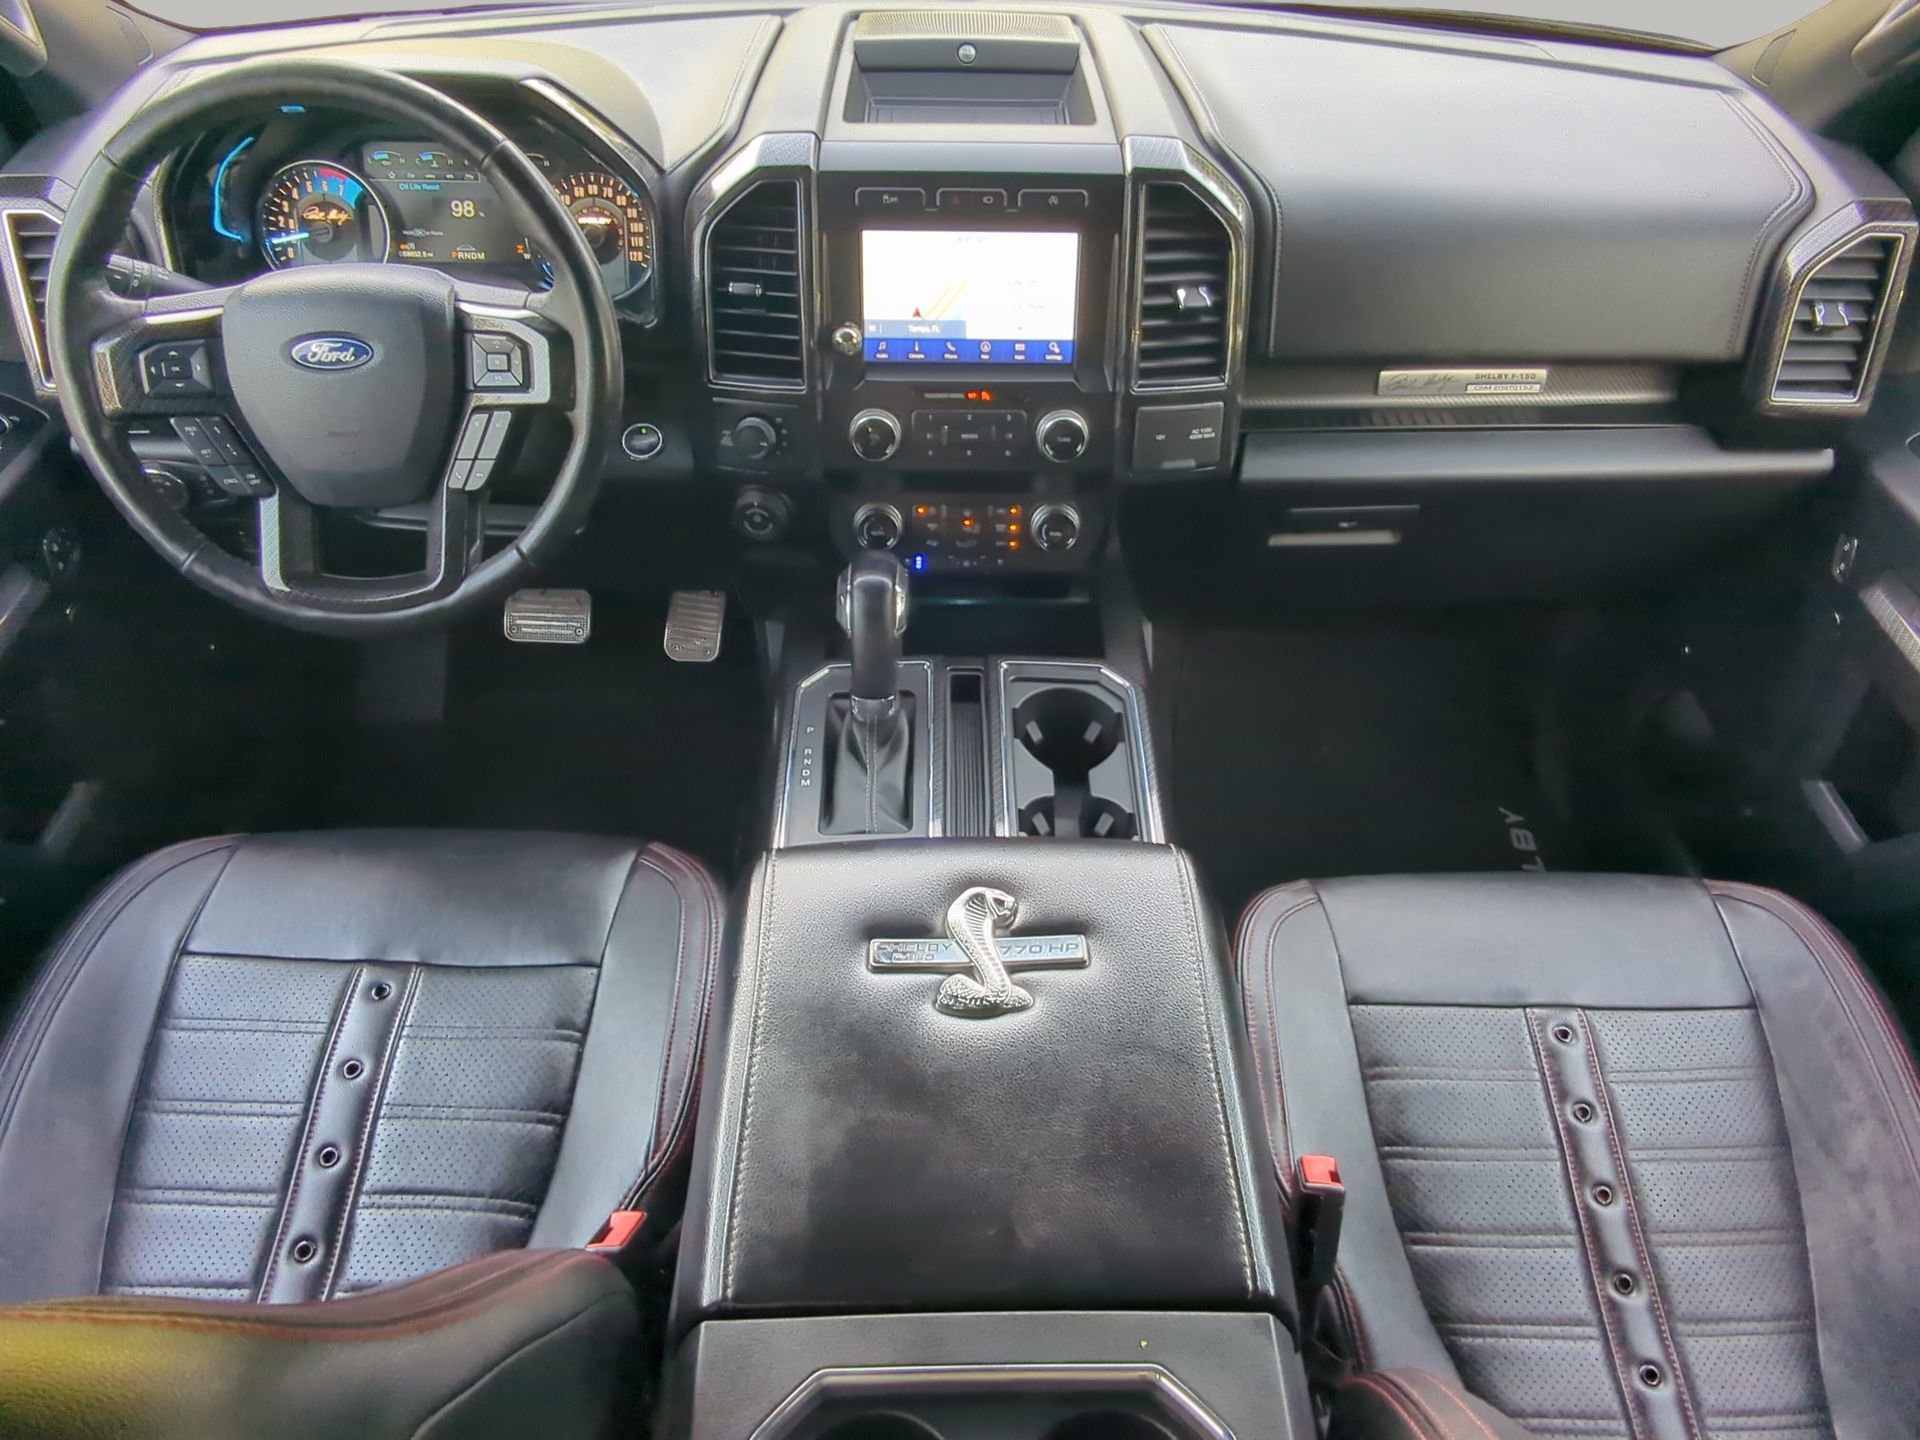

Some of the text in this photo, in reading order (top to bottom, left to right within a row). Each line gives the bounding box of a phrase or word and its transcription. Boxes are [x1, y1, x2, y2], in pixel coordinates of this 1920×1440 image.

[450, 200, 476, 218] 98
[629, 250, 643, 262] 120
[306, 342, 359, 363] Ford
[806, 726, 815, 734] P
[803, 758, 812, 766] N
[802, 769, 811, 777] D
[800, 779, 811, 787] M
[1002, 942, 1080, 955] 770 HP
